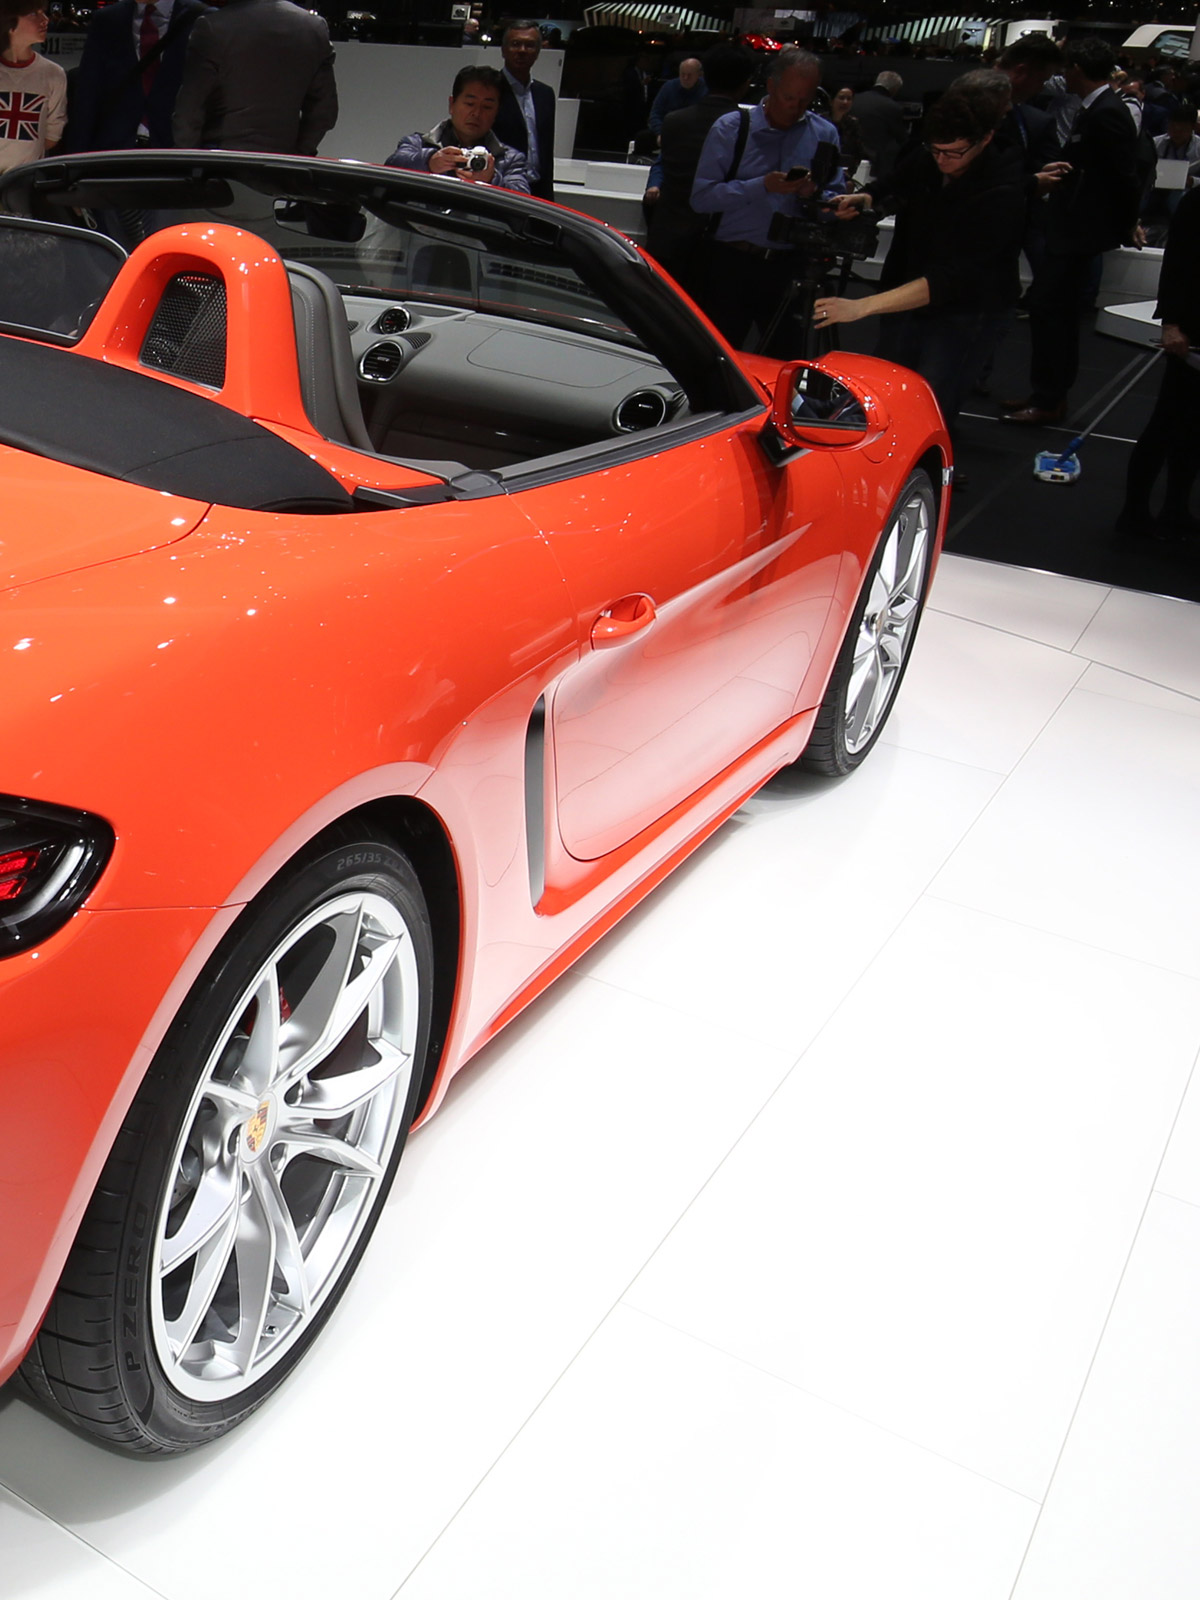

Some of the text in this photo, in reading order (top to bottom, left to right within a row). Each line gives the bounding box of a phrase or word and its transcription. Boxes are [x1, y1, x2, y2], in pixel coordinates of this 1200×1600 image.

[337, 852, 382, 871] 265/35
[123, 1201, 149, 1372] P ZERO
